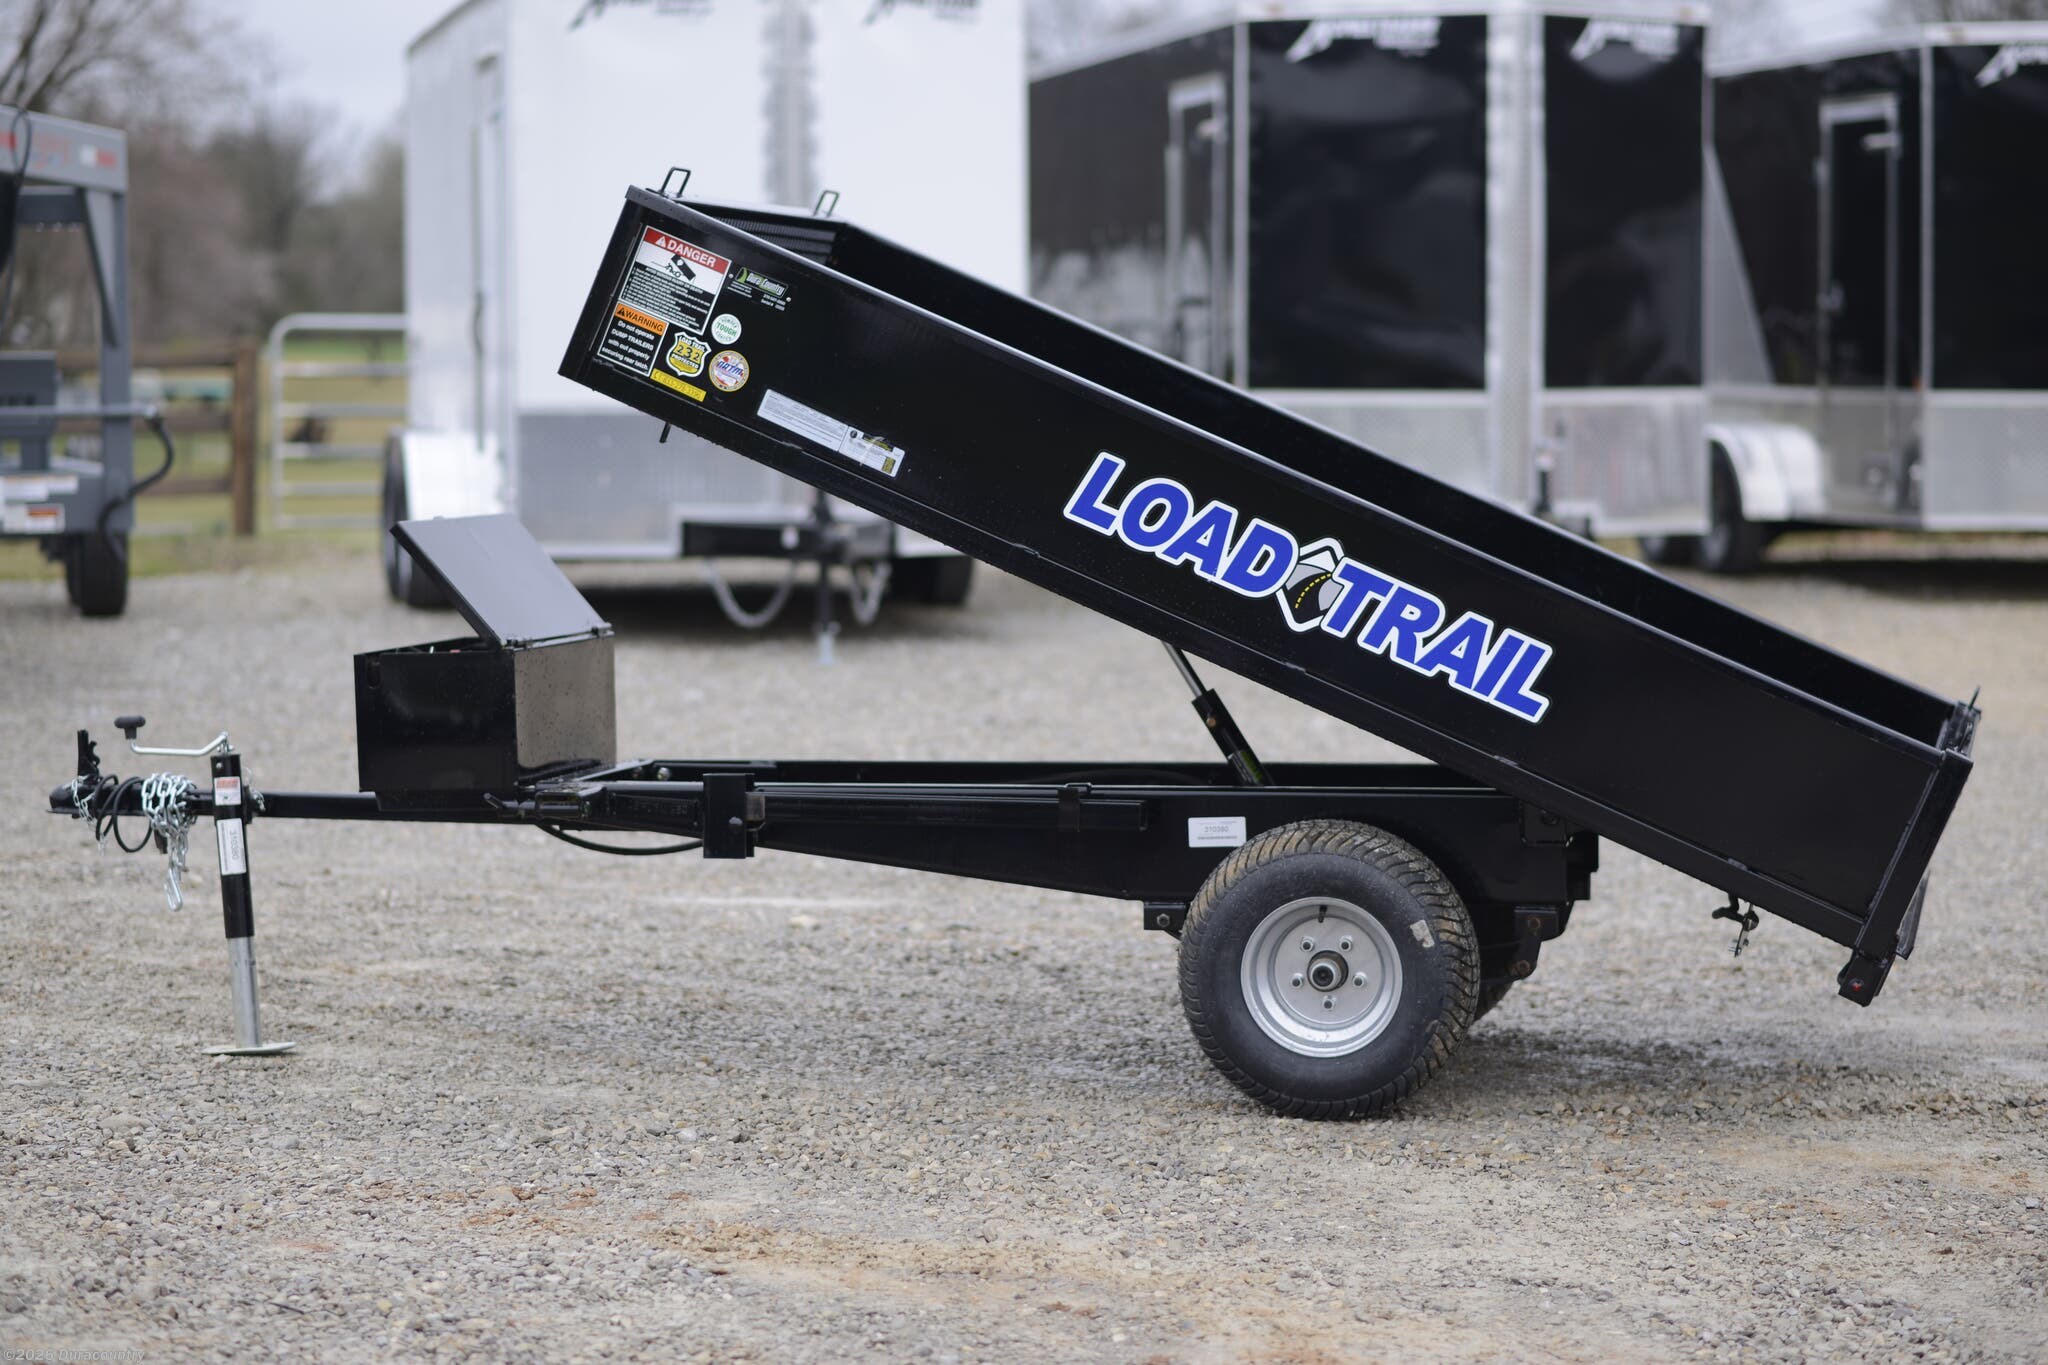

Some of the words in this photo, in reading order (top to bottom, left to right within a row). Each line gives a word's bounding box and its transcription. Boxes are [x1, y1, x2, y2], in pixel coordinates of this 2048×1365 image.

[667, 239, 716, 268] DANGER
[618, 320, 626, 328] Do
[625, 324, 636, 332] not
[635, 328, 655, 340] operate
[626, 311, 663, 332] WARNING
[716, 322, 737, 337] TOUGH
[611, 328, 628, 339] DUMP
[627, 335, 654, 351] TRAILERS
[679, 336, 692, 346] LOAD
[692, 340, 706, 352] TRAIL
[602, 347, 624, 361] securing
[623, 356, 635, 364] rear
[608, 339, 620, 347] with
[619, 343, 629, 351] out
[628, 347, 650, 361] properly
[671, 353, 699, 369] PROTECTED
[1063, 451, 1300, 598] LOAD
[1320, 556, 1553, 723] TRAIL
